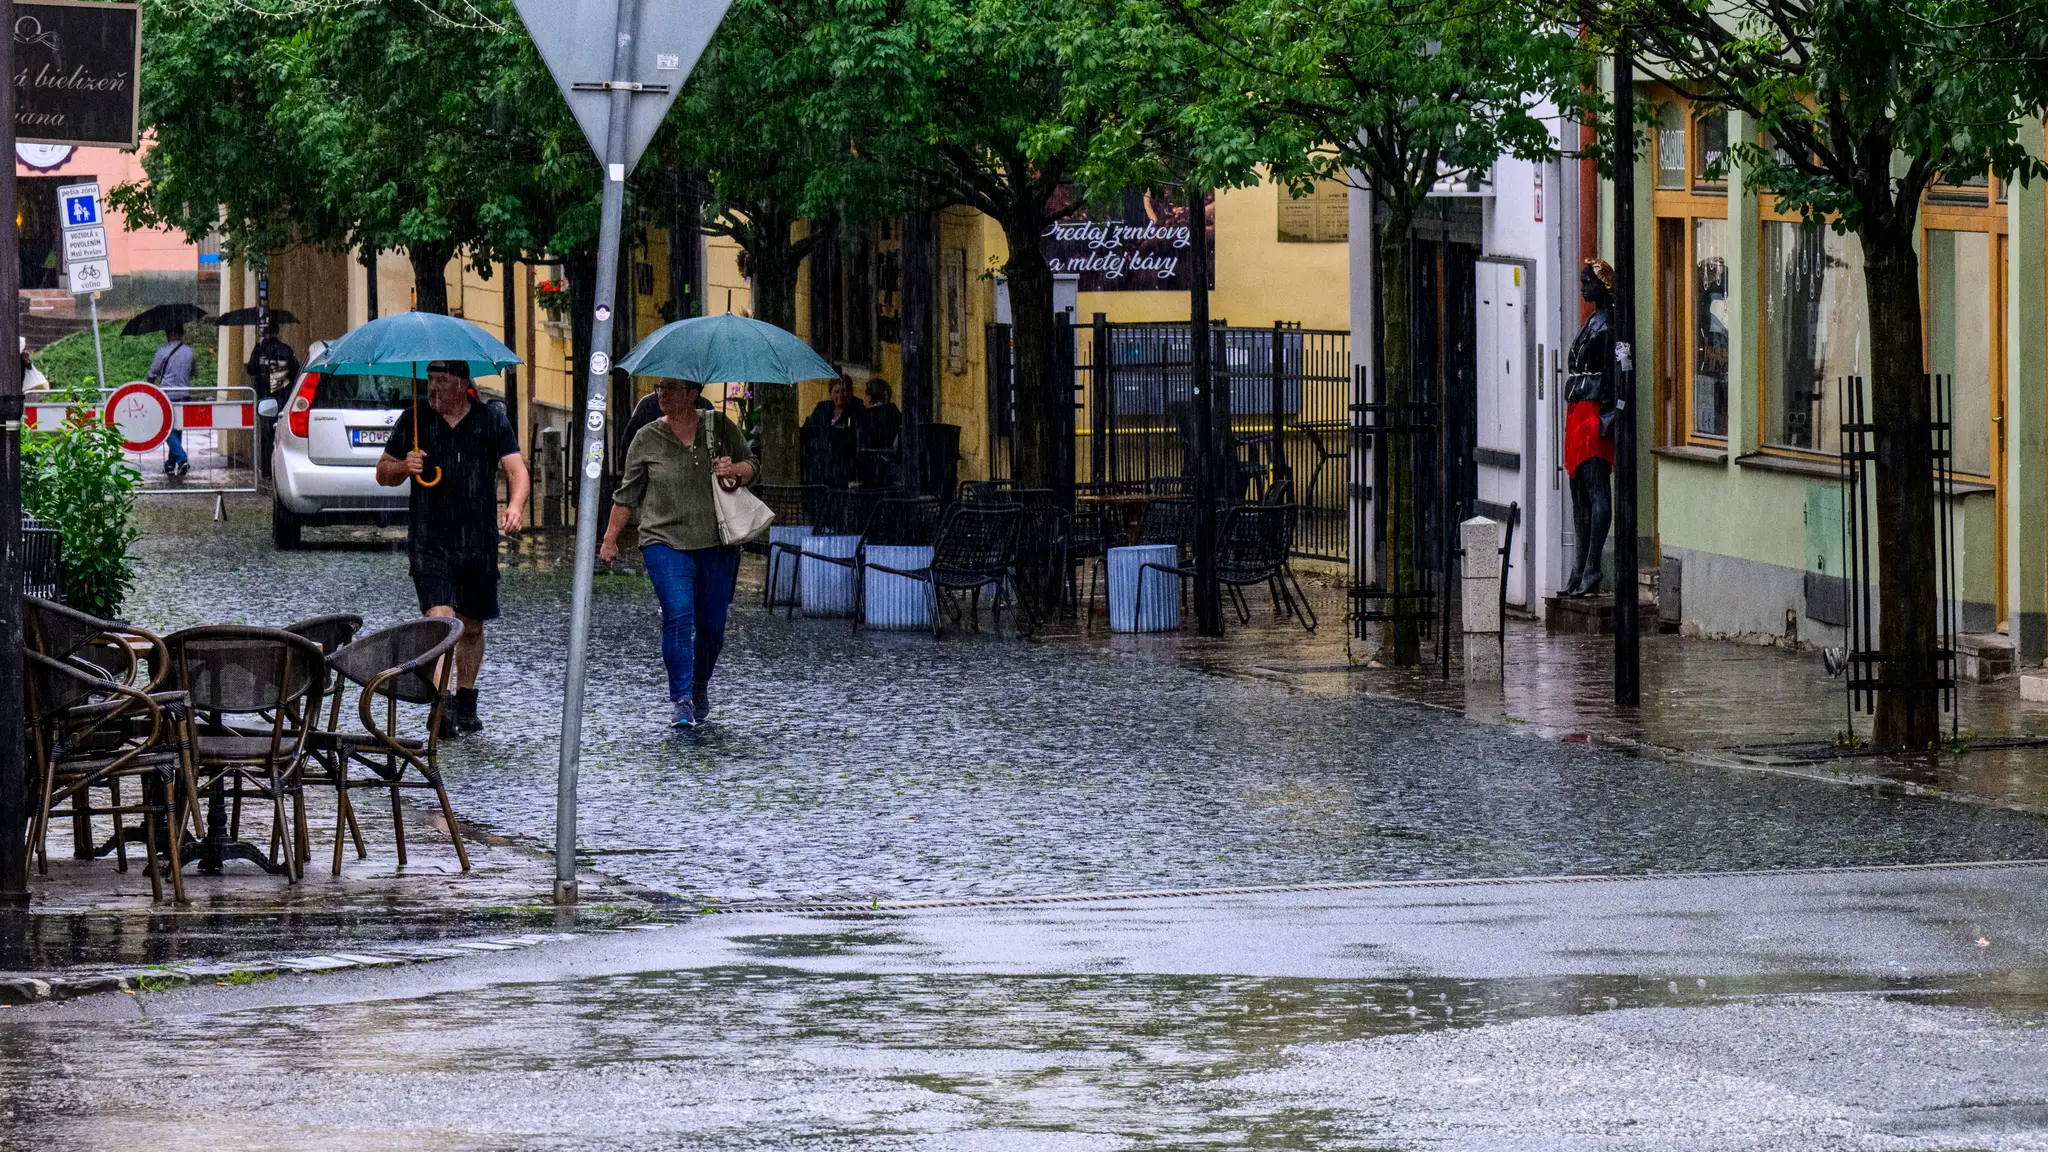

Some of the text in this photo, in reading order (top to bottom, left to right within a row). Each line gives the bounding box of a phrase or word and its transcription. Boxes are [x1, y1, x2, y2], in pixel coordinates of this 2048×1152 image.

[35, 63, 127, 91] bielizeň
[81, 186, 97, 194] zóna
[70, 238, 101, 248] POVOLENÍM
[1105, 220, 1190, 249] zrnkovej
[84, 248, 102, 256] Prešov
[1050, 250, 1178, 279] a mletej kávy
